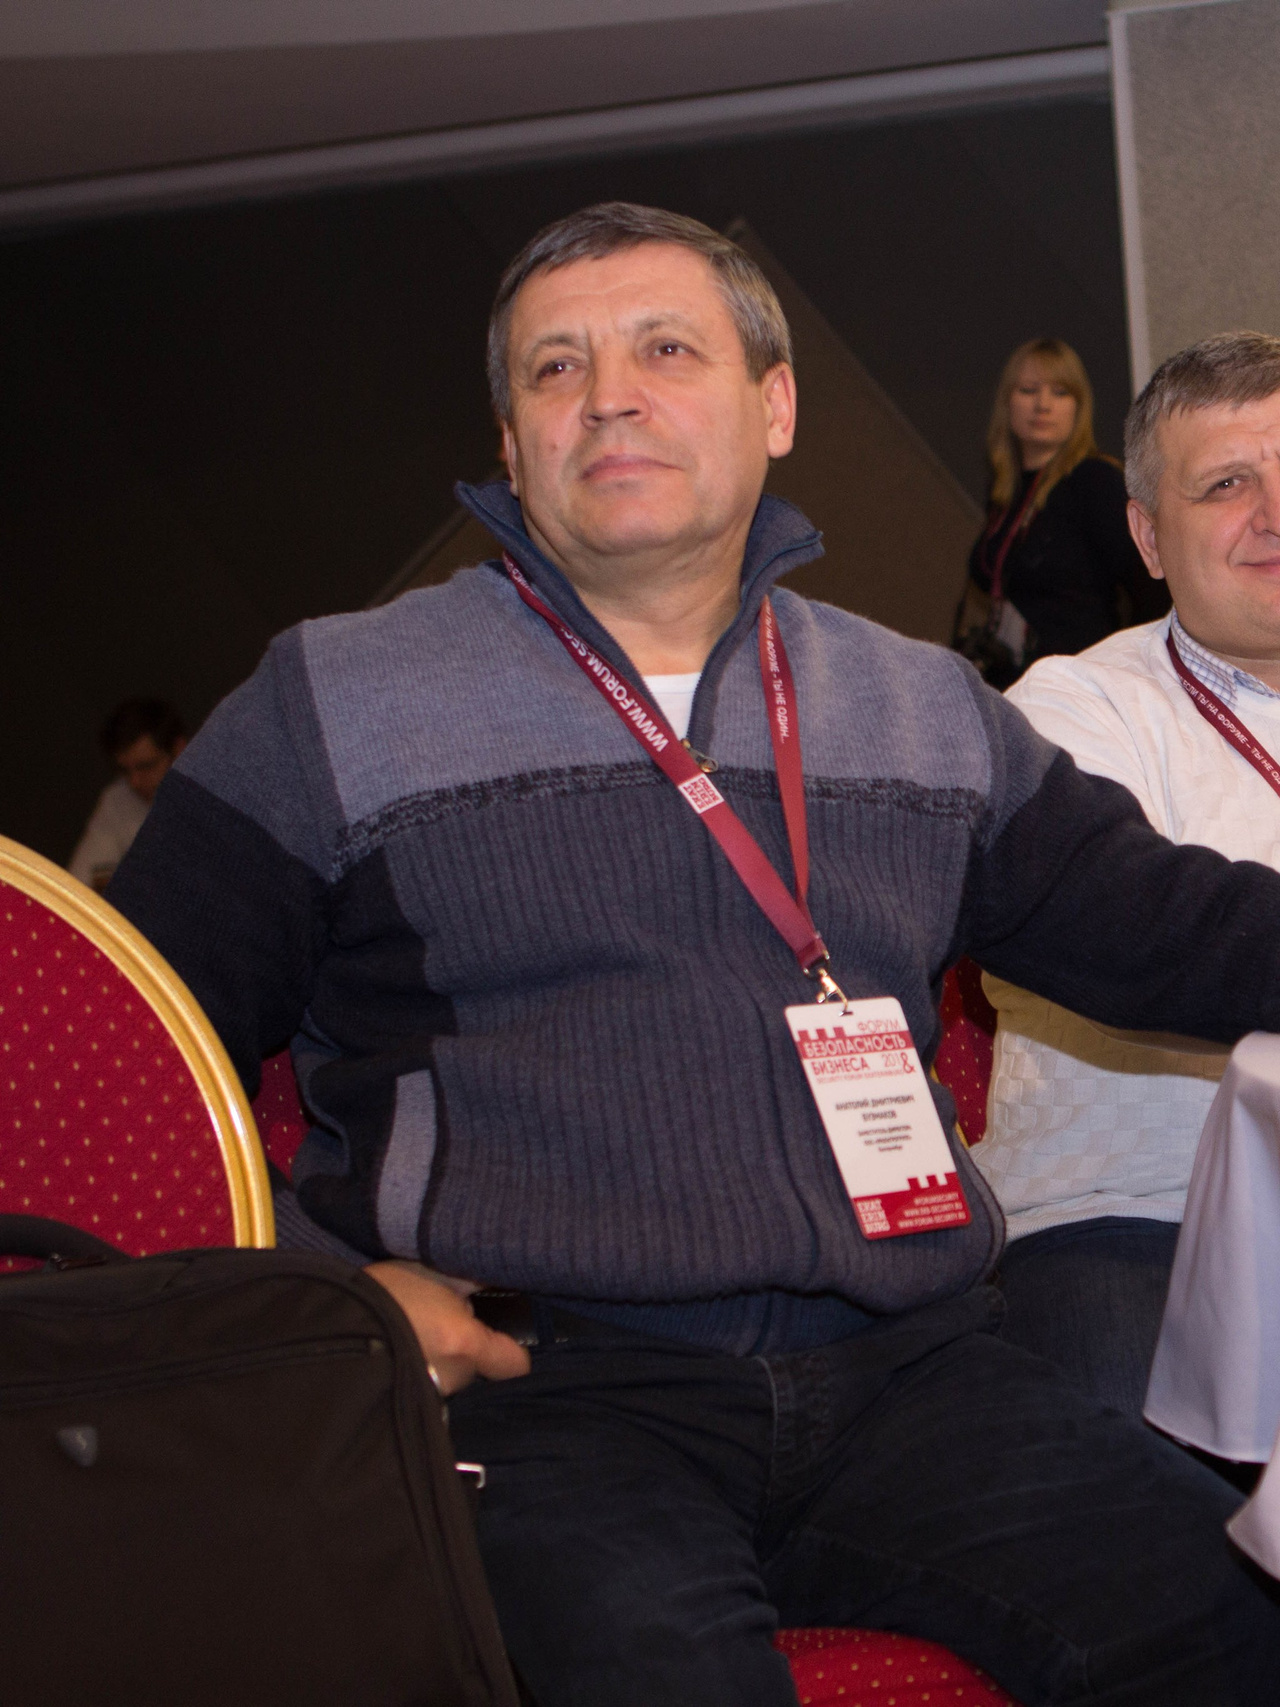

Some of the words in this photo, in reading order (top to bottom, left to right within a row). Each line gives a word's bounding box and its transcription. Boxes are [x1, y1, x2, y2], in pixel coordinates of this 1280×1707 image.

[773, 678, 784, 693] ТЫ
[776, 692, 787, 706] НЕ
[1198, 693, 1210, 707] ТЫ
[1207, 702, 1219, 716] НА
[1217, 713, 1249, 744] ФОРУМЕ
[1251, 747, 1264, 761] ТЫ
[1260, 758, 1274, 772] НЕ
[857, 1019, 901, 1034] ФОРУМ
[803, 1033, 907, 1057] БЕЗОПАСНОСТЬ
[811, 1057, 870, 1075] БИЗНЕСА
